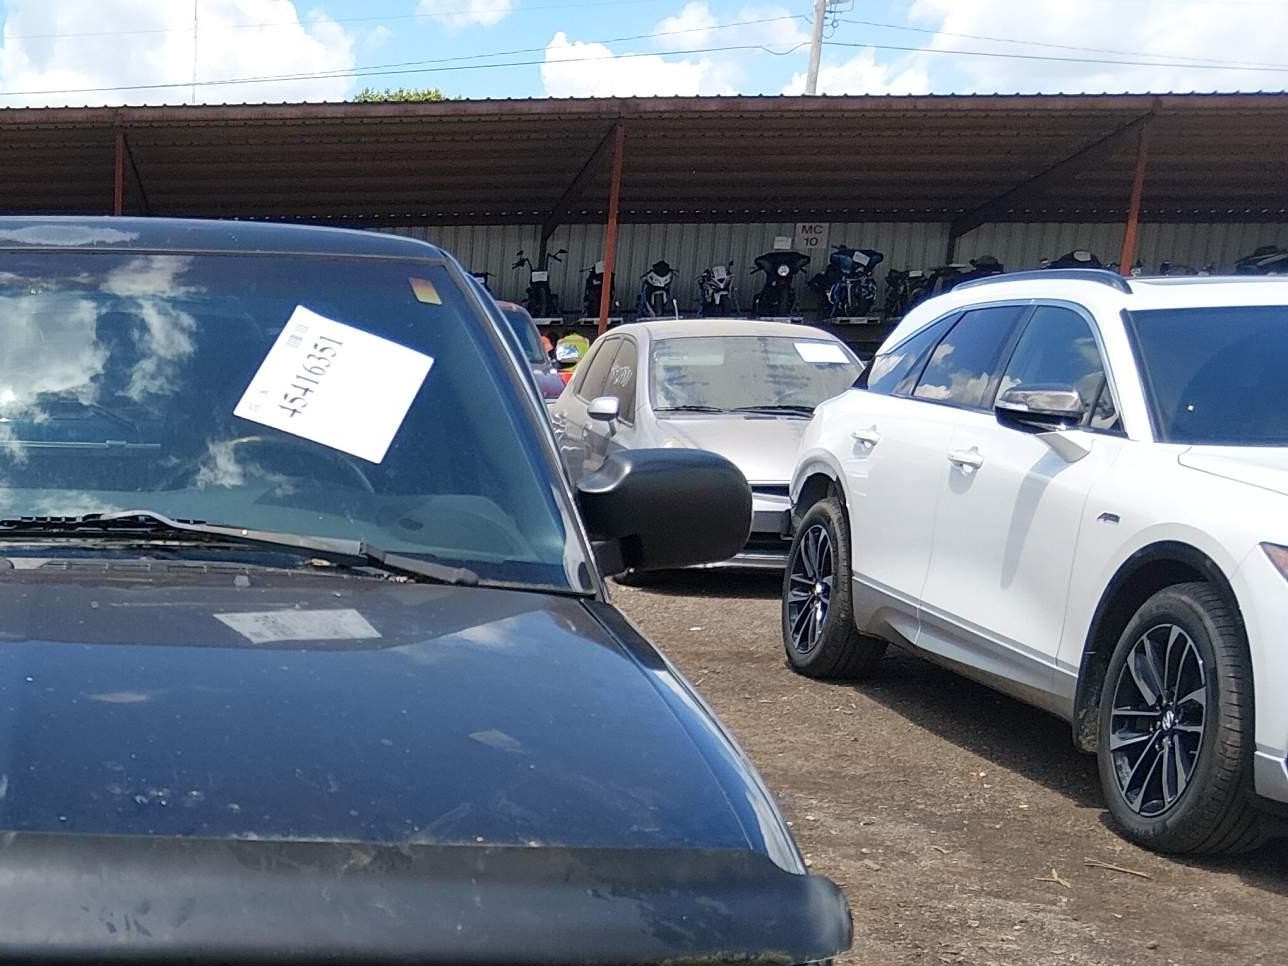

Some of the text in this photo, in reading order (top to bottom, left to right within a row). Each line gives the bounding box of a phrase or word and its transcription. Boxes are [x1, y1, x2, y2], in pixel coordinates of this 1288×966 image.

[801, 225, 823, 235] MC
[804, 237, 819, 247] 10
[277, 335, 344, 418] 45416351
